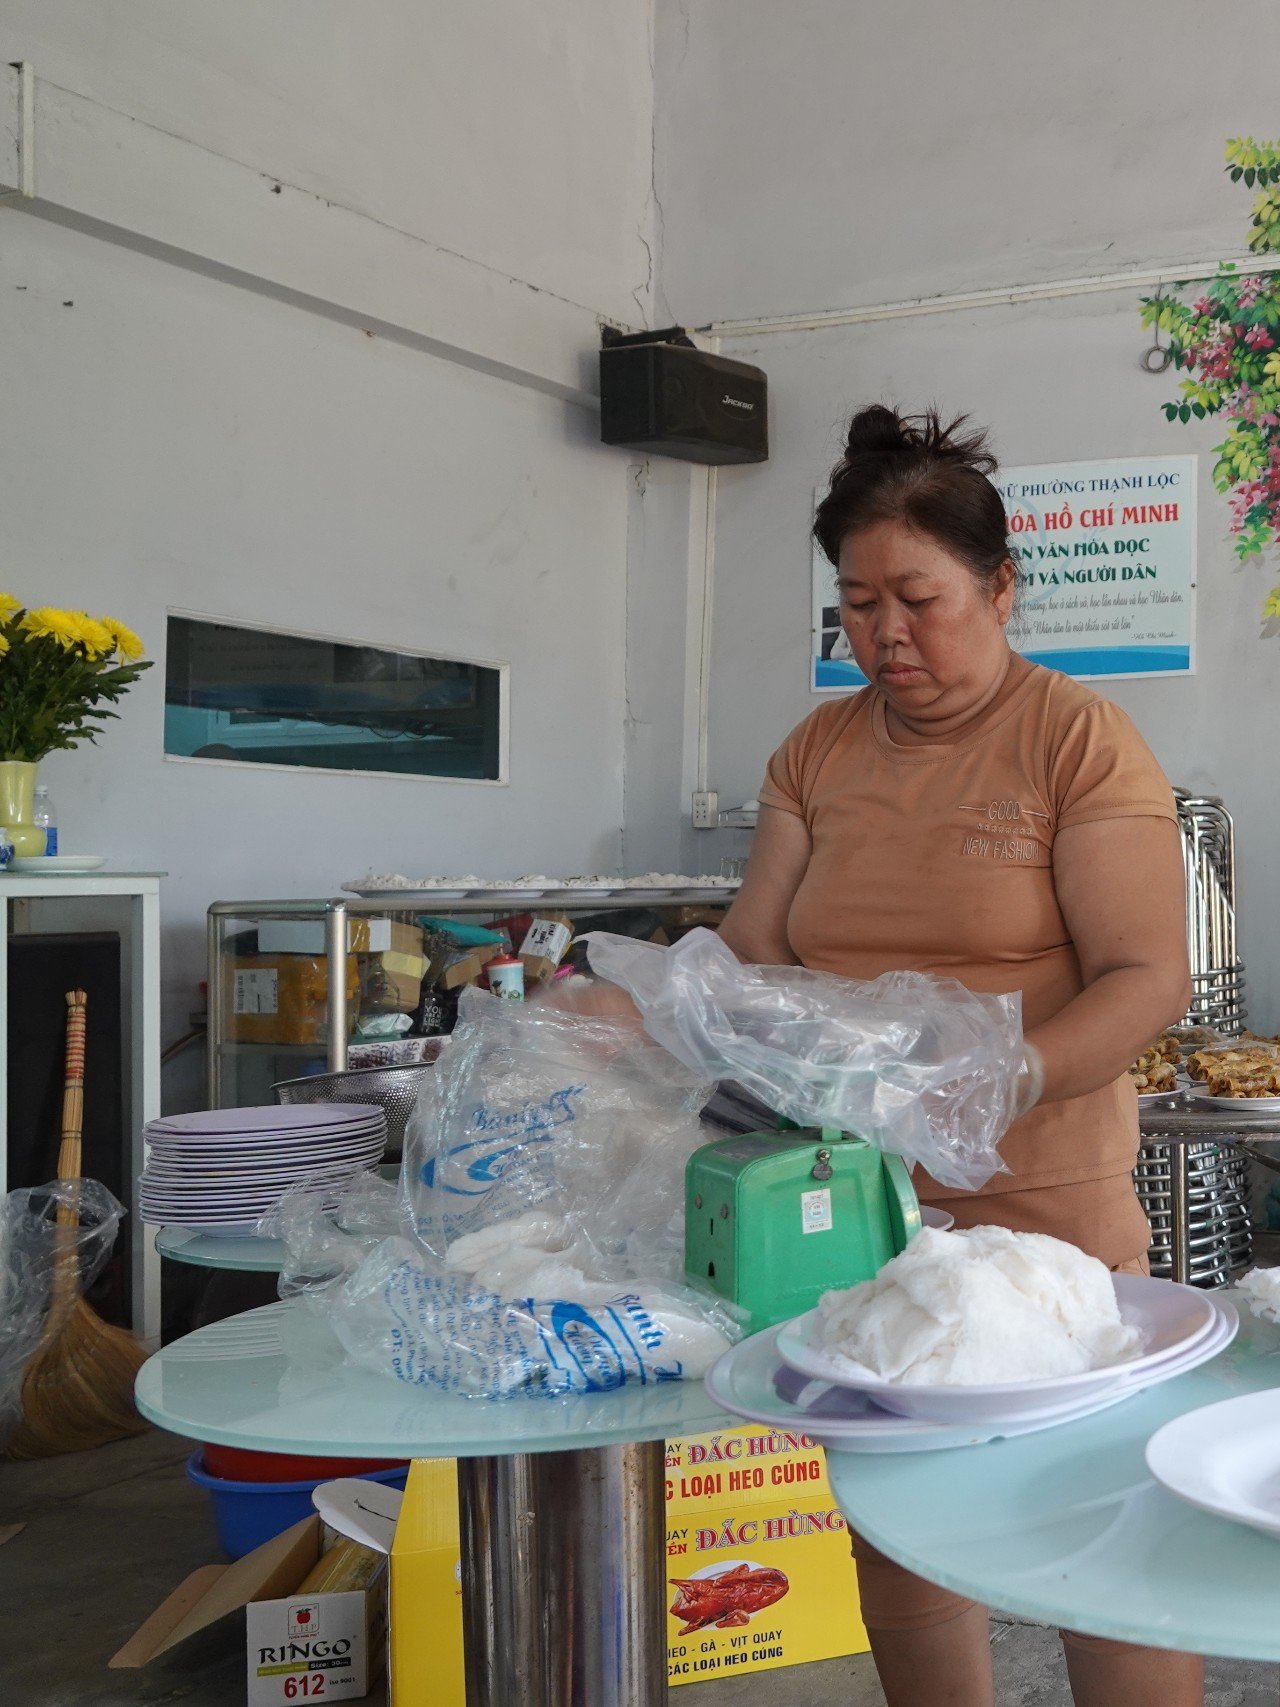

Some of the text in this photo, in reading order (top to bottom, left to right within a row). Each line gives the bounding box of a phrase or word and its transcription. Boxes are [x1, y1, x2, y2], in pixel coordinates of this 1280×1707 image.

[1021, 479, 1085, 497] PHƯỜNG
[1089, 475, 1143, 494] THẠNH
[1147, 471, 1180, 490] LỘC
[1004, 501, 1180, 533] ÓA HỒ CHÍ MINH
[1038, 541, 1070, 560] VĂN
[1074, 538, 1109, 557] HÓA
[1113, 537, 1150, 557] ĐỌC
[1038, 567, 1059, 586] VÀ
[1063, 565, 1117, 584] NGƯỜI
[1121, 562, 1158, 580] DÂN
[988, 800, 1020, 820] GOOD
[962, 837, 1039, 860] NEW FASHION
[666, 1443, 682, 1454] AY
[688, 1429, 819, 1466] ĐẮC HÙNG
[681, 1473, 721, 1499] LOẠI
[729, 1467, 764, 1492] HEO
[771, 1460, 820, 1486] CÚNG
[695, 1509, 846, 1552] ĐẮC HÙNG
[258, 1638, 352, 1665] RINGO
[700, 1638, 717, 1653] GÀ
[730, 1635, 749, 1649] VỊT
[752, 1629, 783, 1644] QUAY
[693, 1657, 721, 1672] LOẠI
[724, 1652, 748, 1666] HEO
[751, 1646, 783, 1661] CÚNG
[284, 1673, 326, 1699] 612
